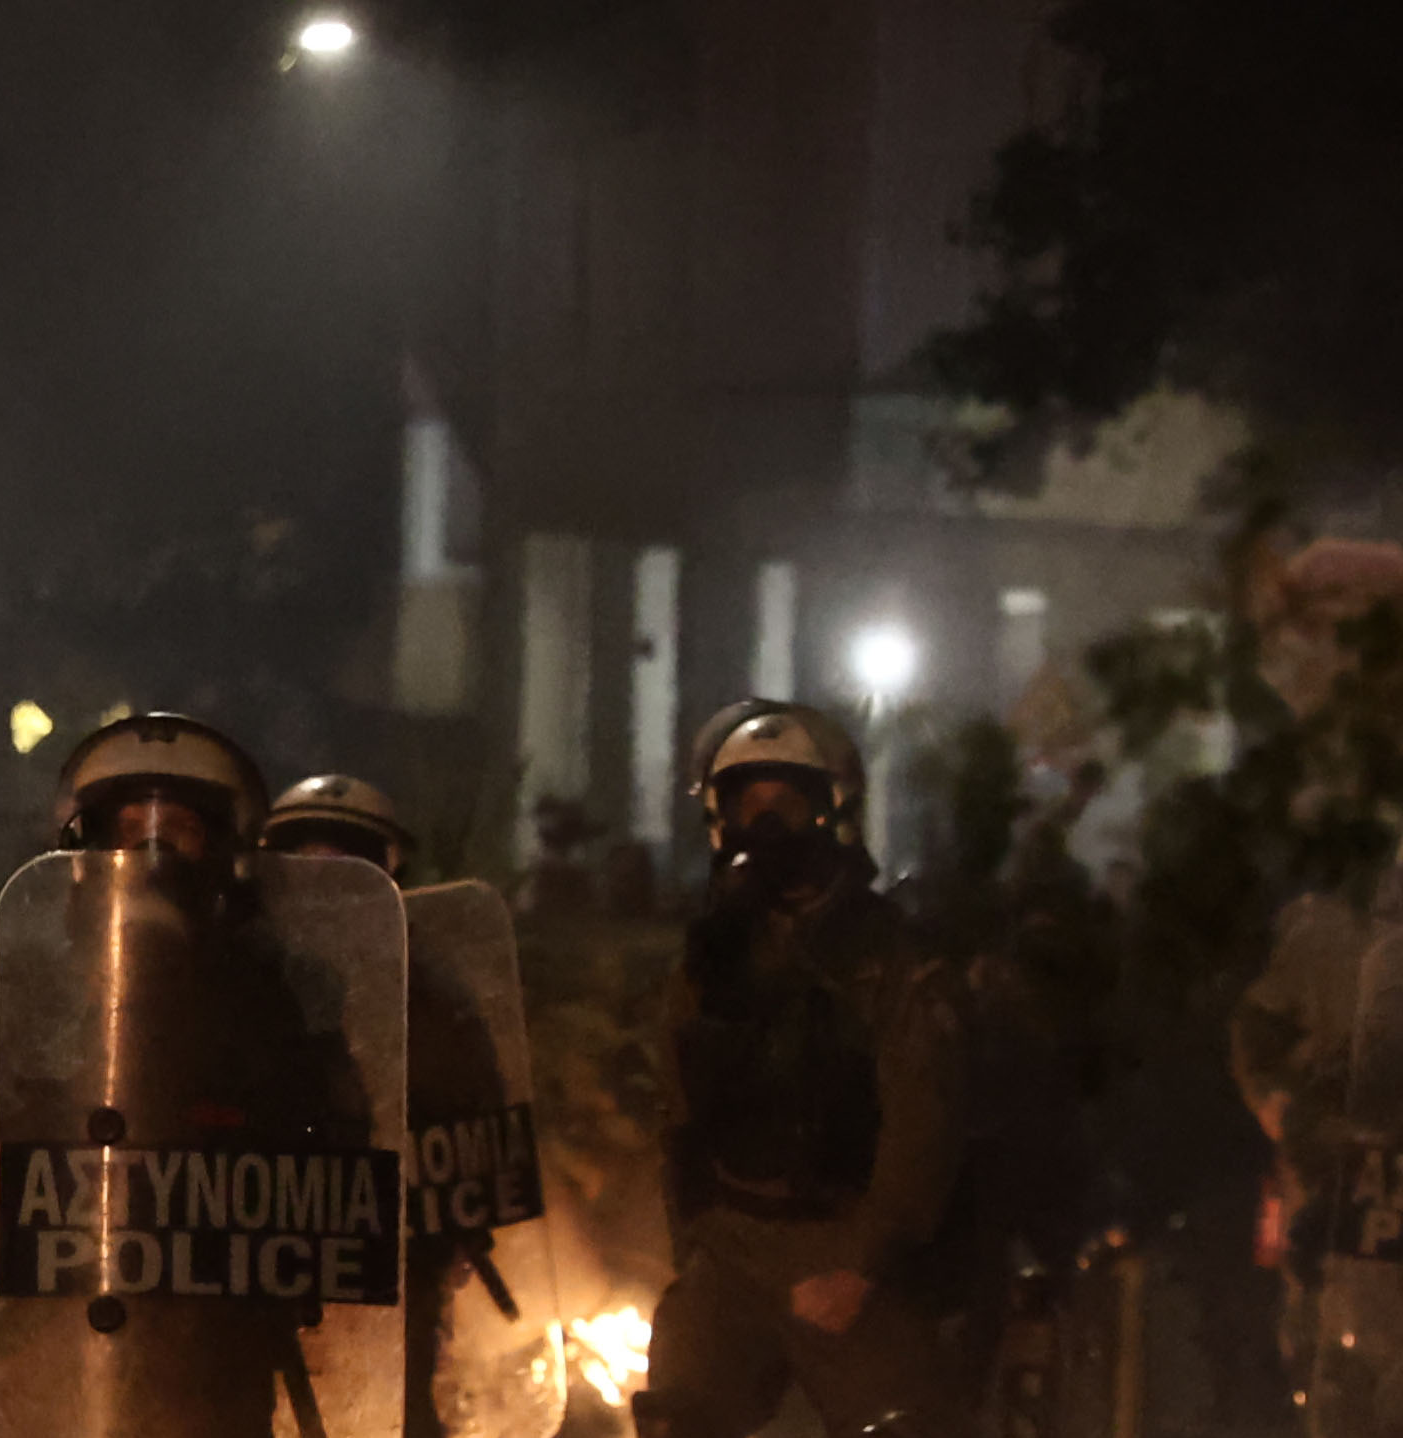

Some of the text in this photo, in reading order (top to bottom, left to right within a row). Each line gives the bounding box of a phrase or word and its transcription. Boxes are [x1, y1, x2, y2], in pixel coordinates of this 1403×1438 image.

[19, 1148, 383, 1235] ΑΣΤΥΝΟΜΙΑ
[407, 1171, 529, 1240] ICE
[36, 1230, 366, 1301] POLICE
